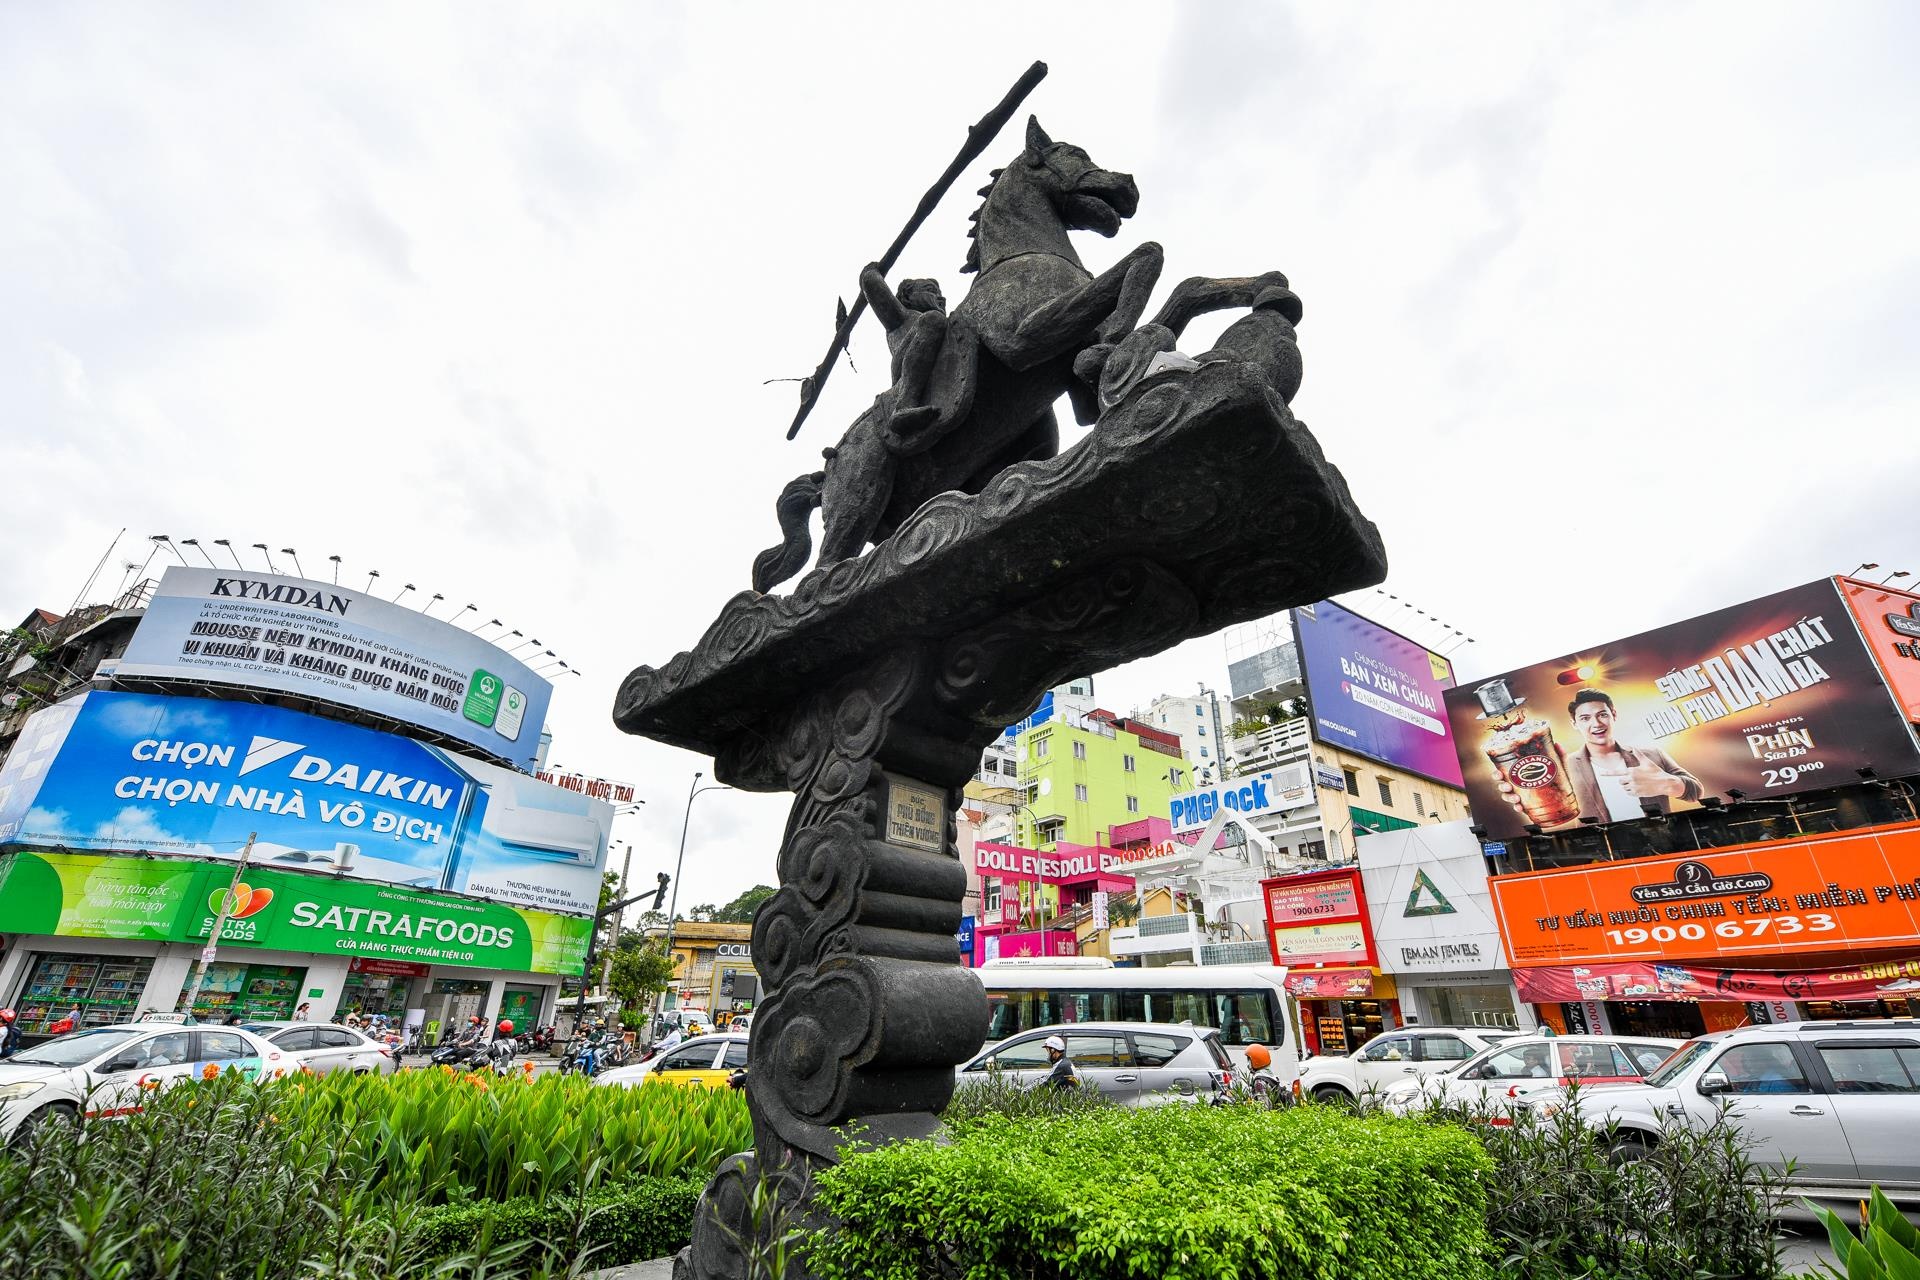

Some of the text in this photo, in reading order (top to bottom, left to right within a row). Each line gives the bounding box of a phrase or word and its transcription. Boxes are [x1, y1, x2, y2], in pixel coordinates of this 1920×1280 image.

[210, 578, 352, 616] KYMDAN
[219, 604, 280, 618] UNDERWRITERS
[280, 611, 339, 629] LABORATORIES
[190, 621, 465, 698] MOUSSE NỆM KYMDAN KHÁNG ĐƯỢC
[1654, 616, 1834, 713] SỐNG ĐẬM CHẤT
[183, 640, 201, 655] VI
[201, 640, 260, 662] KHUẨN
[262, 647, 287, 666] VÀ
[288, 655, 349, 679] KHÁNG
[350, 667, 393, 691] ĐƯỢC
[394, 680, 430, 703] NẤM
[430, 692, 460, 713] MỐC
[1341, 656, 1371, 685] BẠN
[1372, 670, 1401, 698] XEM
[1682, 690, 1731, 727] PHIN
[1742, 716, 1804, 734] HIGHLANDS
[1746, 728, 1815, 760] PHIN
[132, 739, 453, 810] CHỌN DAIKIN
[1511, 756, 1553, 777] HIGHLANDS
[1760, 761, 1825, 789] 29.000
[614, 784, 634, 802] TRAI
[1520, 774, 1554, 790] COFFEE
[114, 775, 444, 845] CHỌN NHÀ VÔ ĐỊCH
[976, 848, 1061, 879] DOLL EYES
[1060, 854, 1098, 879] DOLL
[1273, 897, 1288, 905] BAO
[1634, 886, 1659, 900] Yến
[1661, 883, 1683, 897] Sào
[1685, 879, 1711, 894] Cần
[1005, 903, 1018, 921] HOA
[1293, 905, 1313, 917] 1900
[1313, 903, 1336, 915] 6733
[1535, 915, 1561, 931] TƯ
[1564, 907, 1605, 929] VẤN
[1607, 904, 1662, 927] NUÔI
[1664, 901, 1727, 922] CHIM
[1794, 881, 1869, 910] MIỄN
[203, 917, 257, 931] STRA
[288, 902, 514, 949] SATRAFOODS
[1606, 913, 1836, 946] 1900 6733
[335, 938, 475, 965] CỬA HÀNG THỰC PHẨM TIỆN LỢI
[1440, 943, 1481, 961] JEWELS
